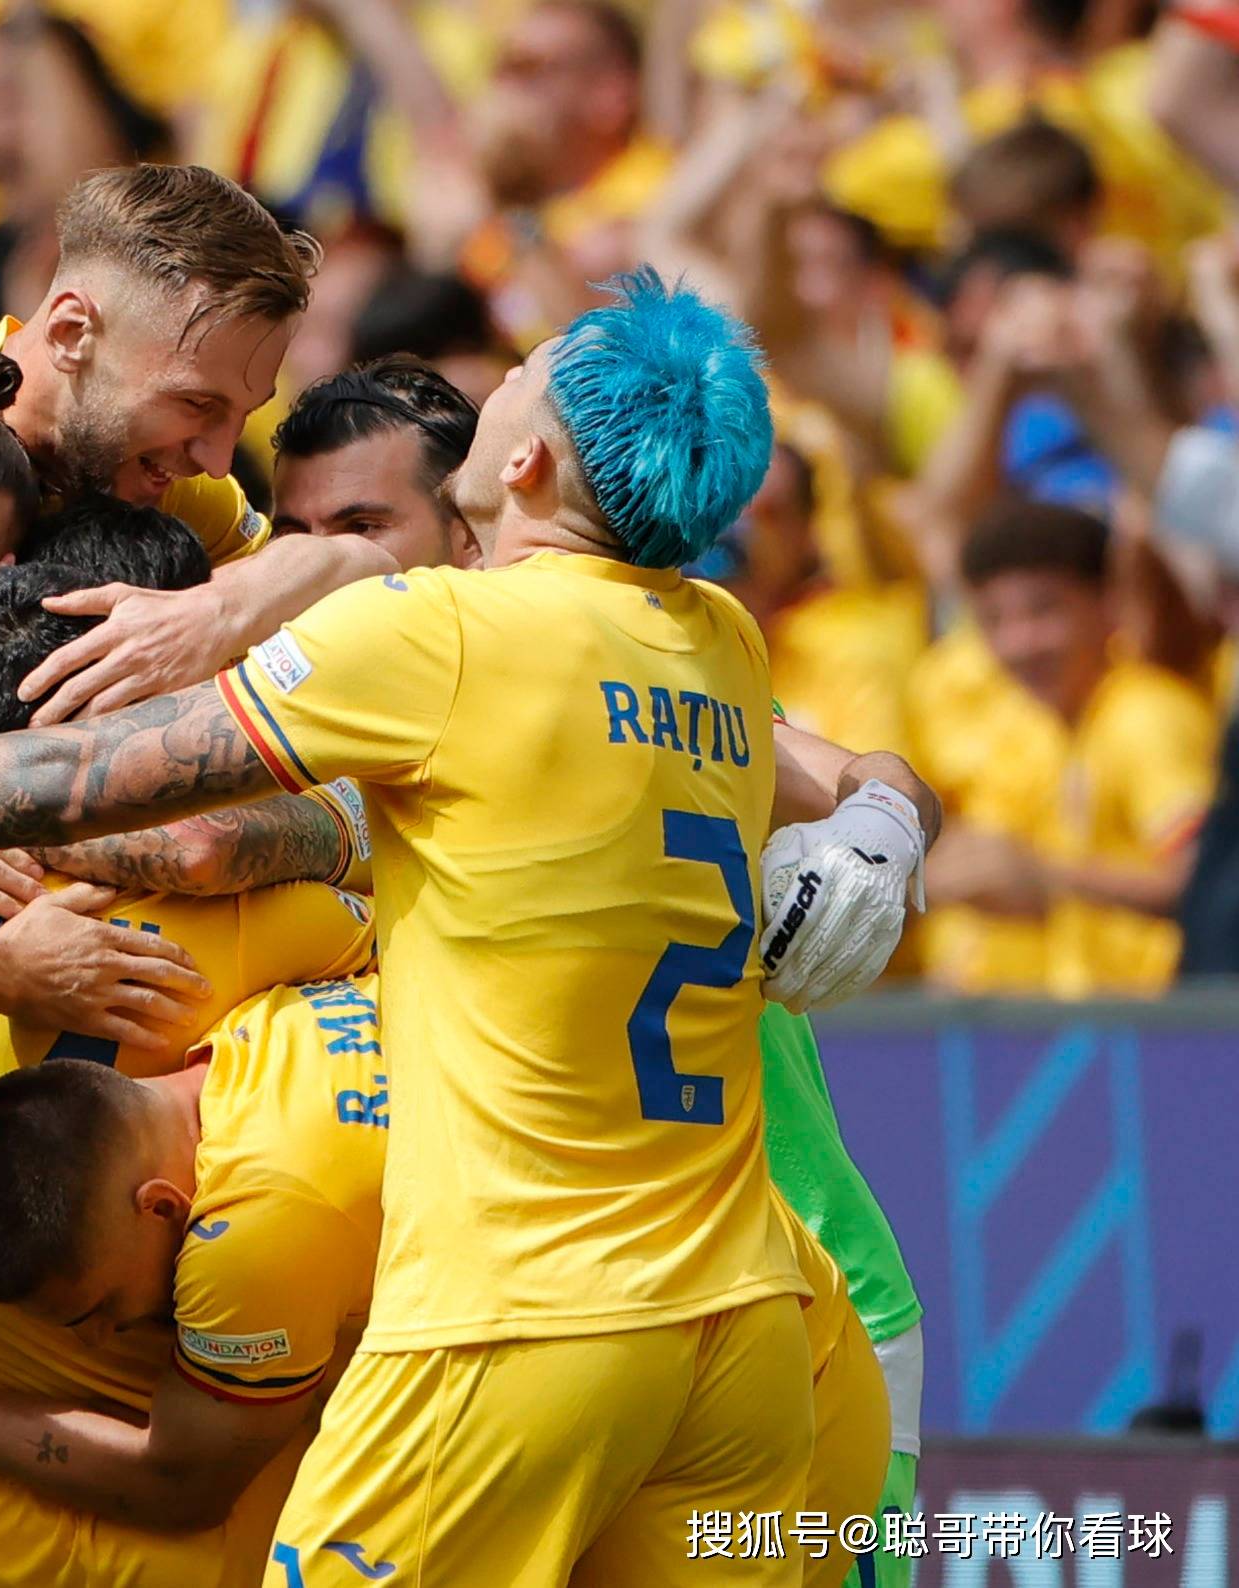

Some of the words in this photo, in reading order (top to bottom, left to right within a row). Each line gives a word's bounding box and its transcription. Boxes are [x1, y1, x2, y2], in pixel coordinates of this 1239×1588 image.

[598, 679, 751, 772] RAȚIU
[627, 808, 755, 1125] 2
[763, 870, 822, 972] reusch
